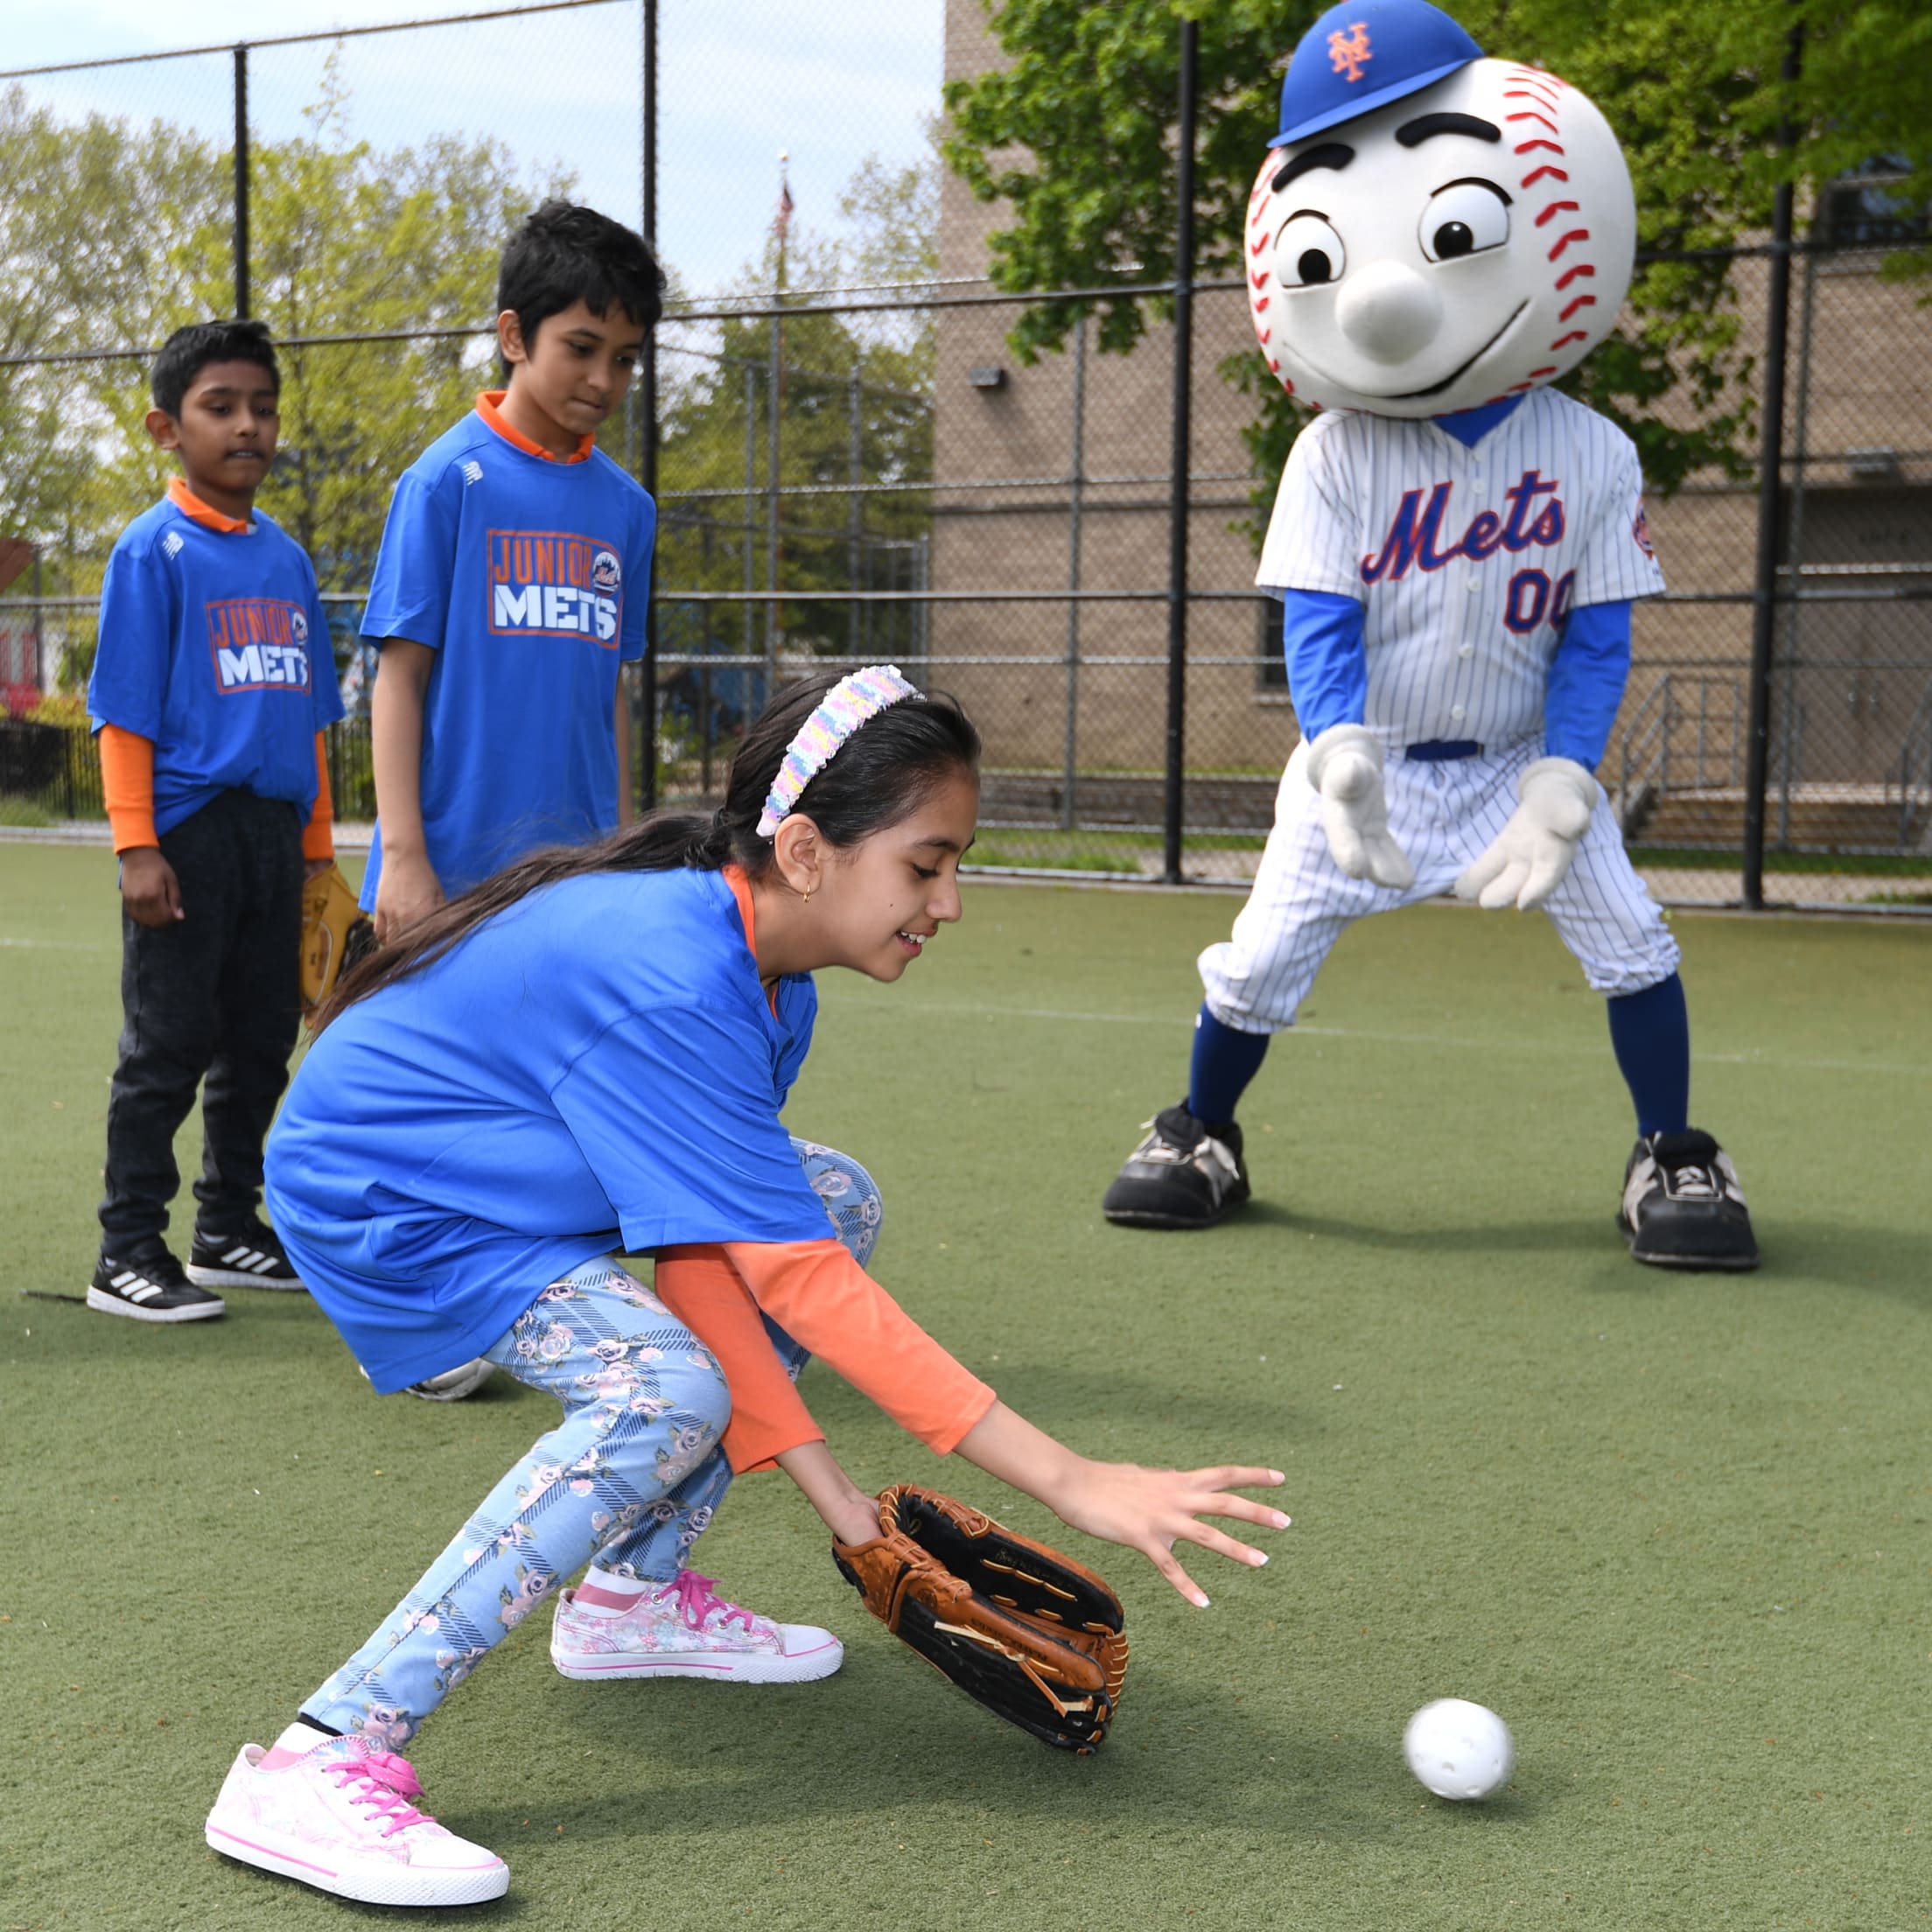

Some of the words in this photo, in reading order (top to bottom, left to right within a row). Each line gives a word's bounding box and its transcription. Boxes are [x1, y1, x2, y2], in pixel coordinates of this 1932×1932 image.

[1361, 470, 1565, 585] Mets
[494, 538, 592, 589] JUNIOR
[216, 606, 295, 648] JUNIOR
[494, 584, 618, 640] METS
